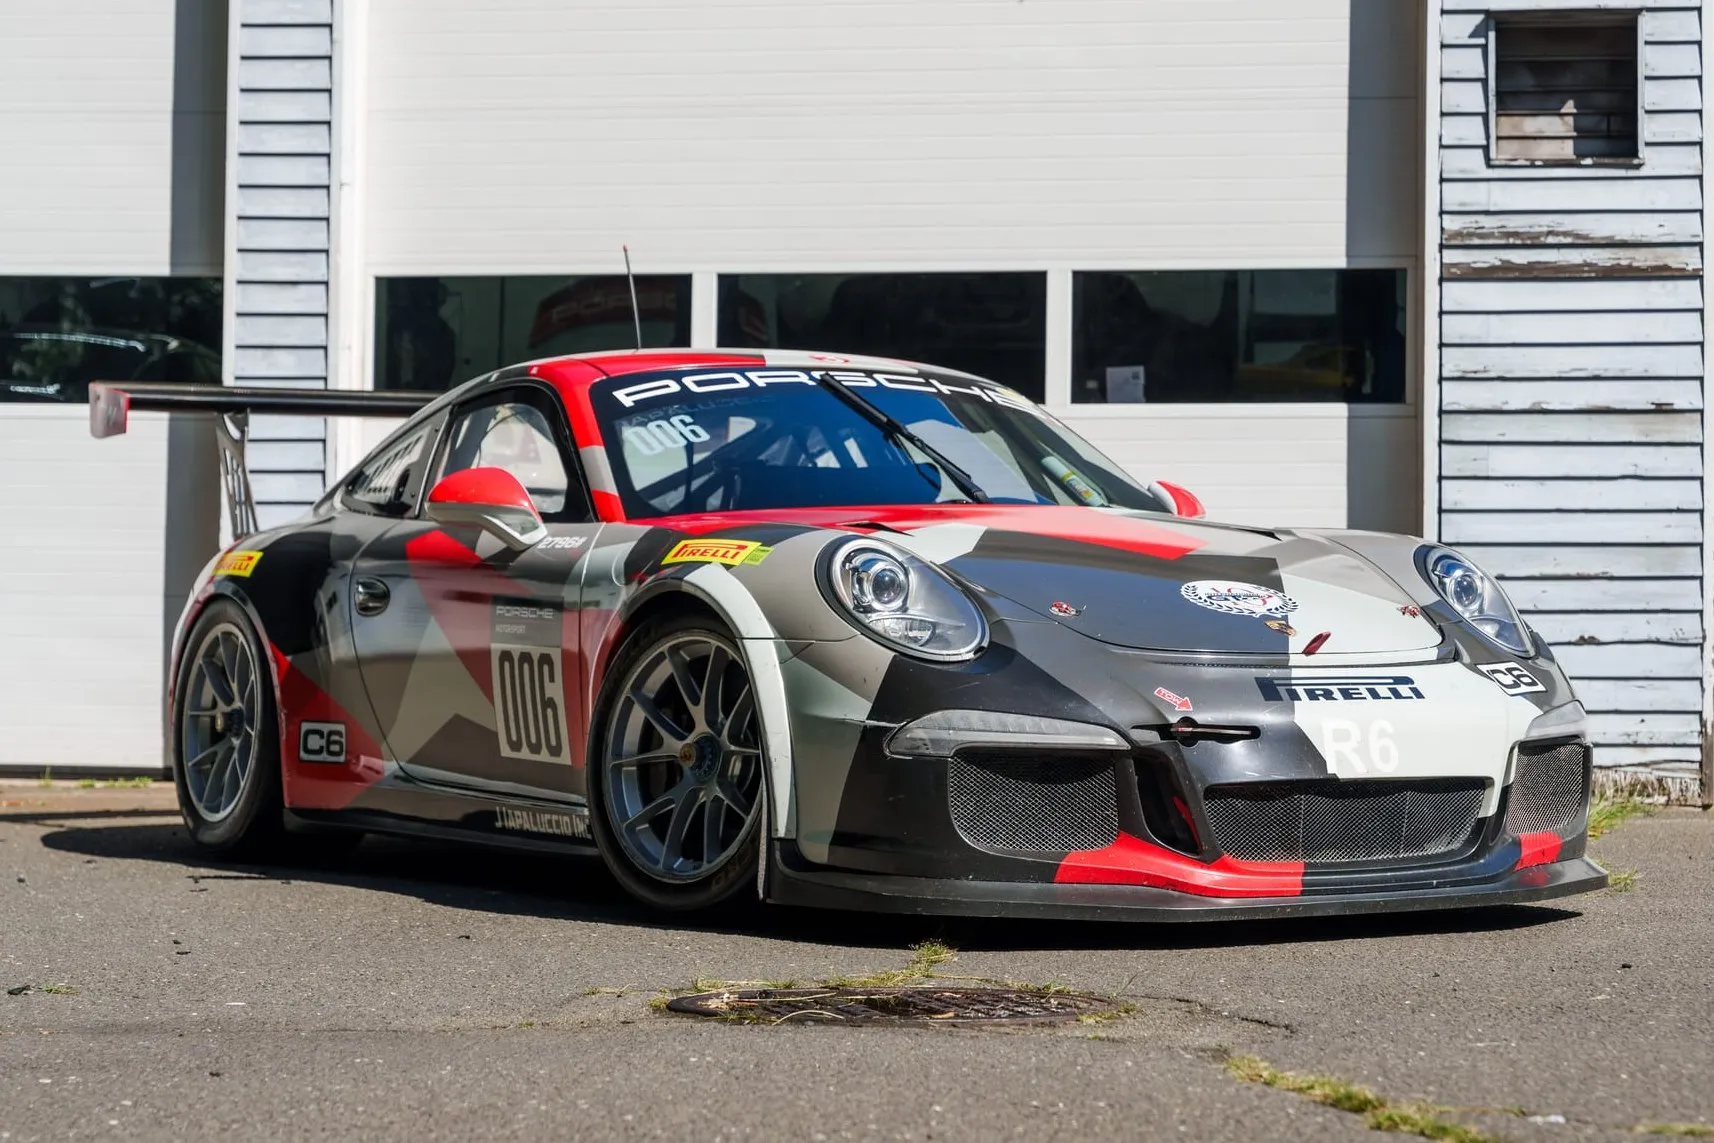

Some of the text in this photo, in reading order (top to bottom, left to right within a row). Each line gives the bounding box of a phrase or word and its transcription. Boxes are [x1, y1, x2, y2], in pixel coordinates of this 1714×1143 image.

[612, 369, 1047, 420] PORSCHE
[622, 414, 711, 456] 006
[672, 542, 748, 560] PIRELLI
[495, 605, 554, 619] PORSCHE
[1254, 675, 1426, 702] PIRELLI
[1486, 666, 1540, 690] C6
[498, 650, 563, 758] 006
[302, 728, 344, 757] C6
[1320, 718, 1399, 775] R6
